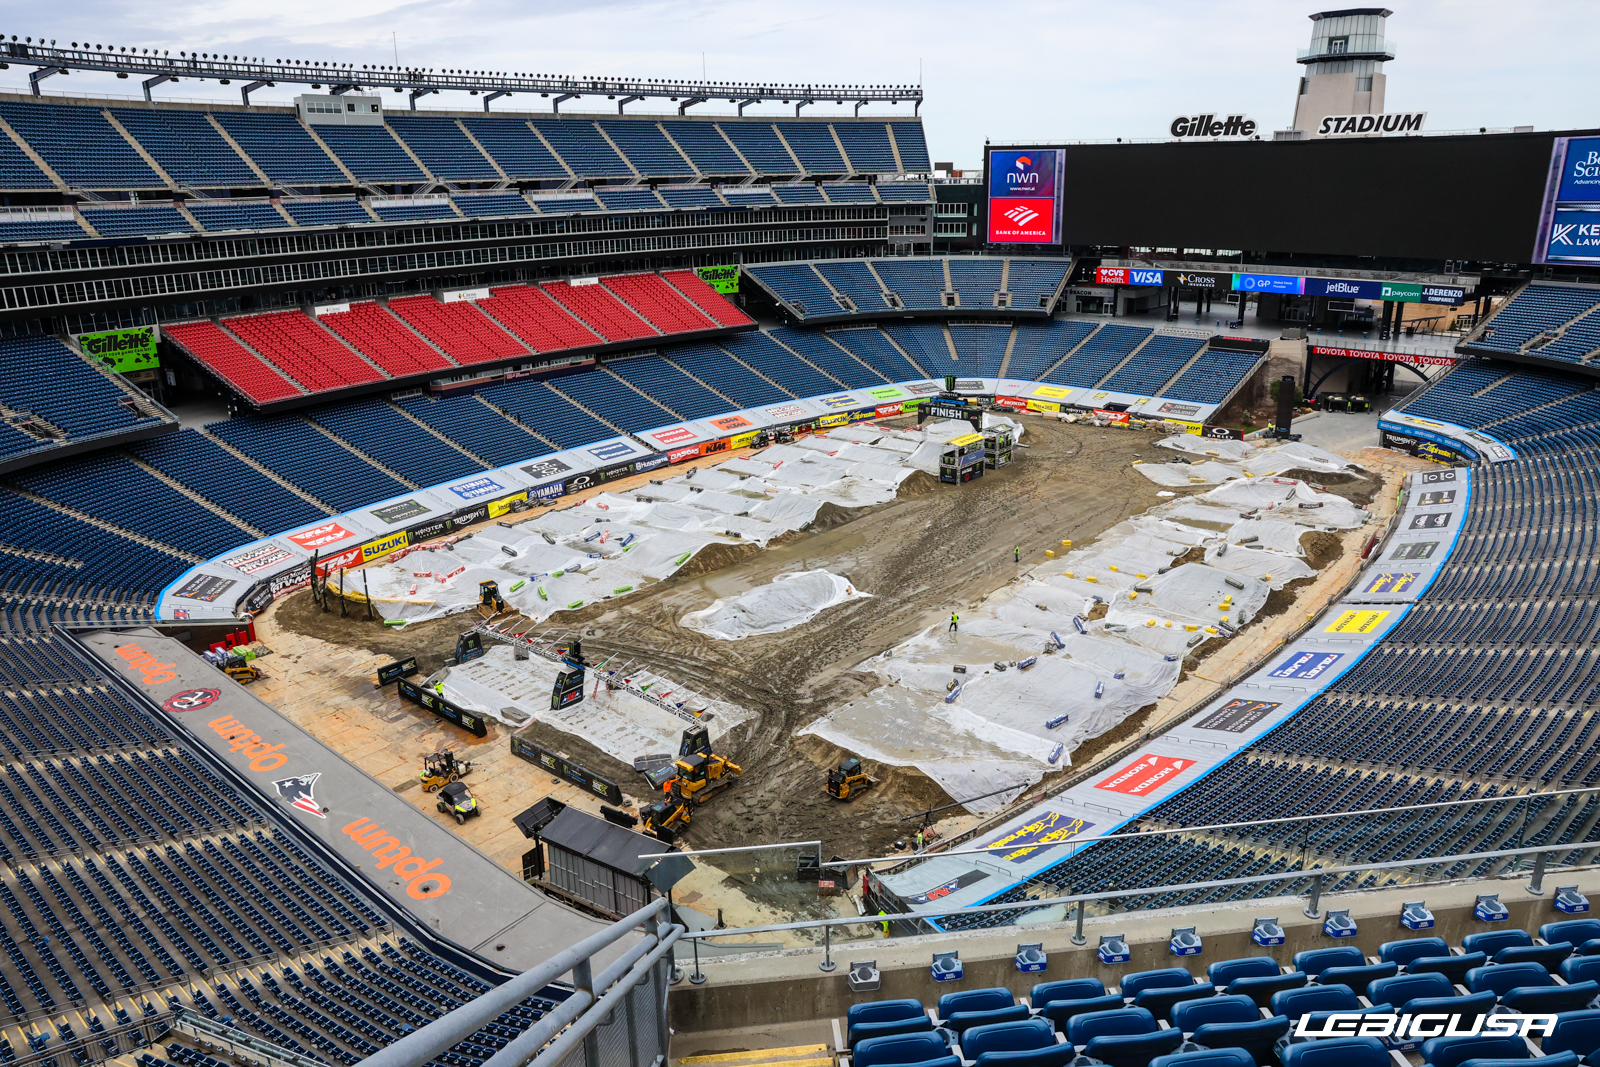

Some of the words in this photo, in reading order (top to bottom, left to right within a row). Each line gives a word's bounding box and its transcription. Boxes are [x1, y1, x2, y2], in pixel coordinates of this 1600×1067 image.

[1171, 115, 1256, 137] Gillette
[1319, 114, 1424, 134] STADIUM
[1574, 161, 1600, 176] Sci
[1007, 173, 1038, 183] nwn
[702, 269, 736, 280] Gillette
[1131, 272, 1162, 284] VISA
[1326, 282, 1359, 294] jetBlue
[1422, 288, 1462, 297] J.DERENZO
[87, 332, 150, 354] Gillette
[1316, 347, 1346, 356] TOYOTA
[1349, 350, 1380, 359] TOYOTA
[1383, 353, 1415, 363] TOYOTA
[1418, 356, 1451, 366] TOYOTA
[931, 407, 962, 418] FINISH
[821, 416, 847, 425] SUZUK
[655, 429, 686, 438] GASGAS
[663, 434, 694, 444] GASGAS
[706, 441, 726, 453] KTM
[670, 448, 699, 460] GASGAS
[641, 456, 668, 468] Husqvarna
[606, 466, 628, 476] MONSTER
[462, 478, 491, 489] YAMAHA
[471, 484, 499, 495] YAMAHA
[536, 484, 563, 498] YAMAHA
[454, 511, 479, 523] TRIUMPH
[297, 523, 336, 538] FLY
[415, 524, 444, 536] MONSTER
[308, 530, 346, 545] FLY
[364, 535, 406, 557] SUZUKI
[319, 550, 360, 570] FLY
[1358, 614, 1378, 632] DUNLOP
[1279, 653, 1314, 677] FALKEN
[1304, 654, 1338, 678] FALKEN
[207, 714, 288, 772] Optum
[1103, 763, 1149, 788] HONDA
[1128, 767, 1174, 793] HONDA
[341, 817, 452, 900] Optum
